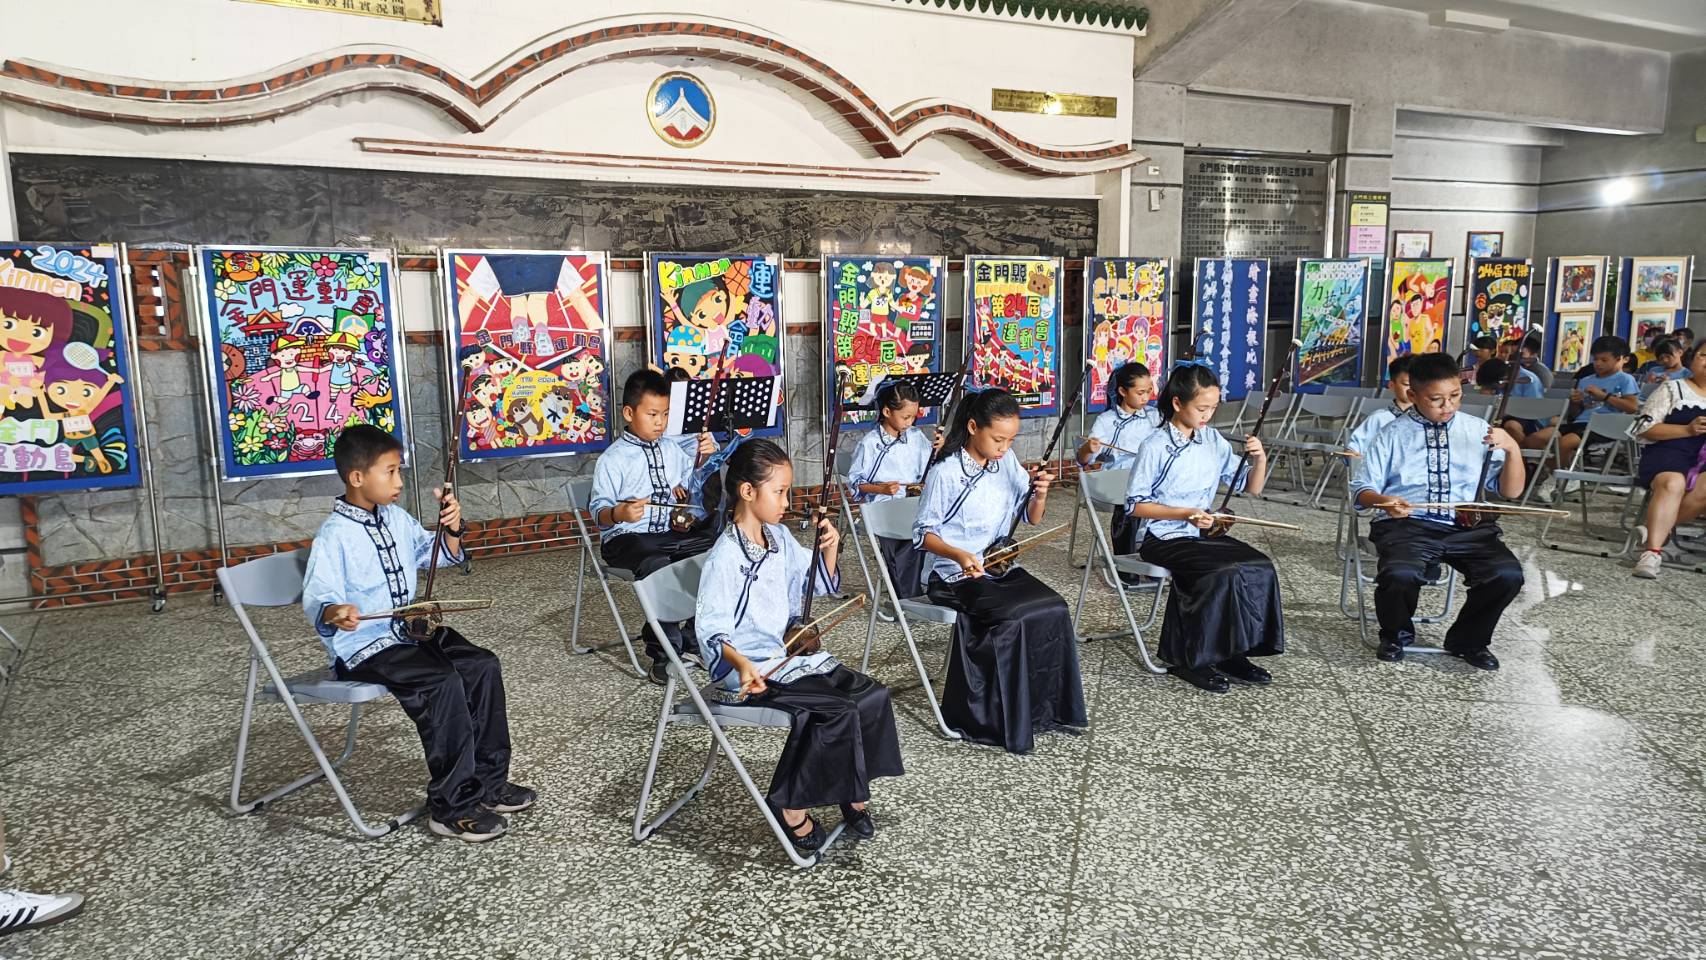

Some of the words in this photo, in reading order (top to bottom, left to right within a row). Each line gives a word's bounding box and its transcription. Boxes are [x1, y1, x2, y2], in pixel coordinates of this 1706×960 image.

[31, 246, 108, 288] 2024
[976, 262, 1027, 284] 金門縣
[991, 293, 1041, 318] 第24屆
[1105, 297, 1119, 315] 24
[1003, 318, 1049, 350] 運動會
